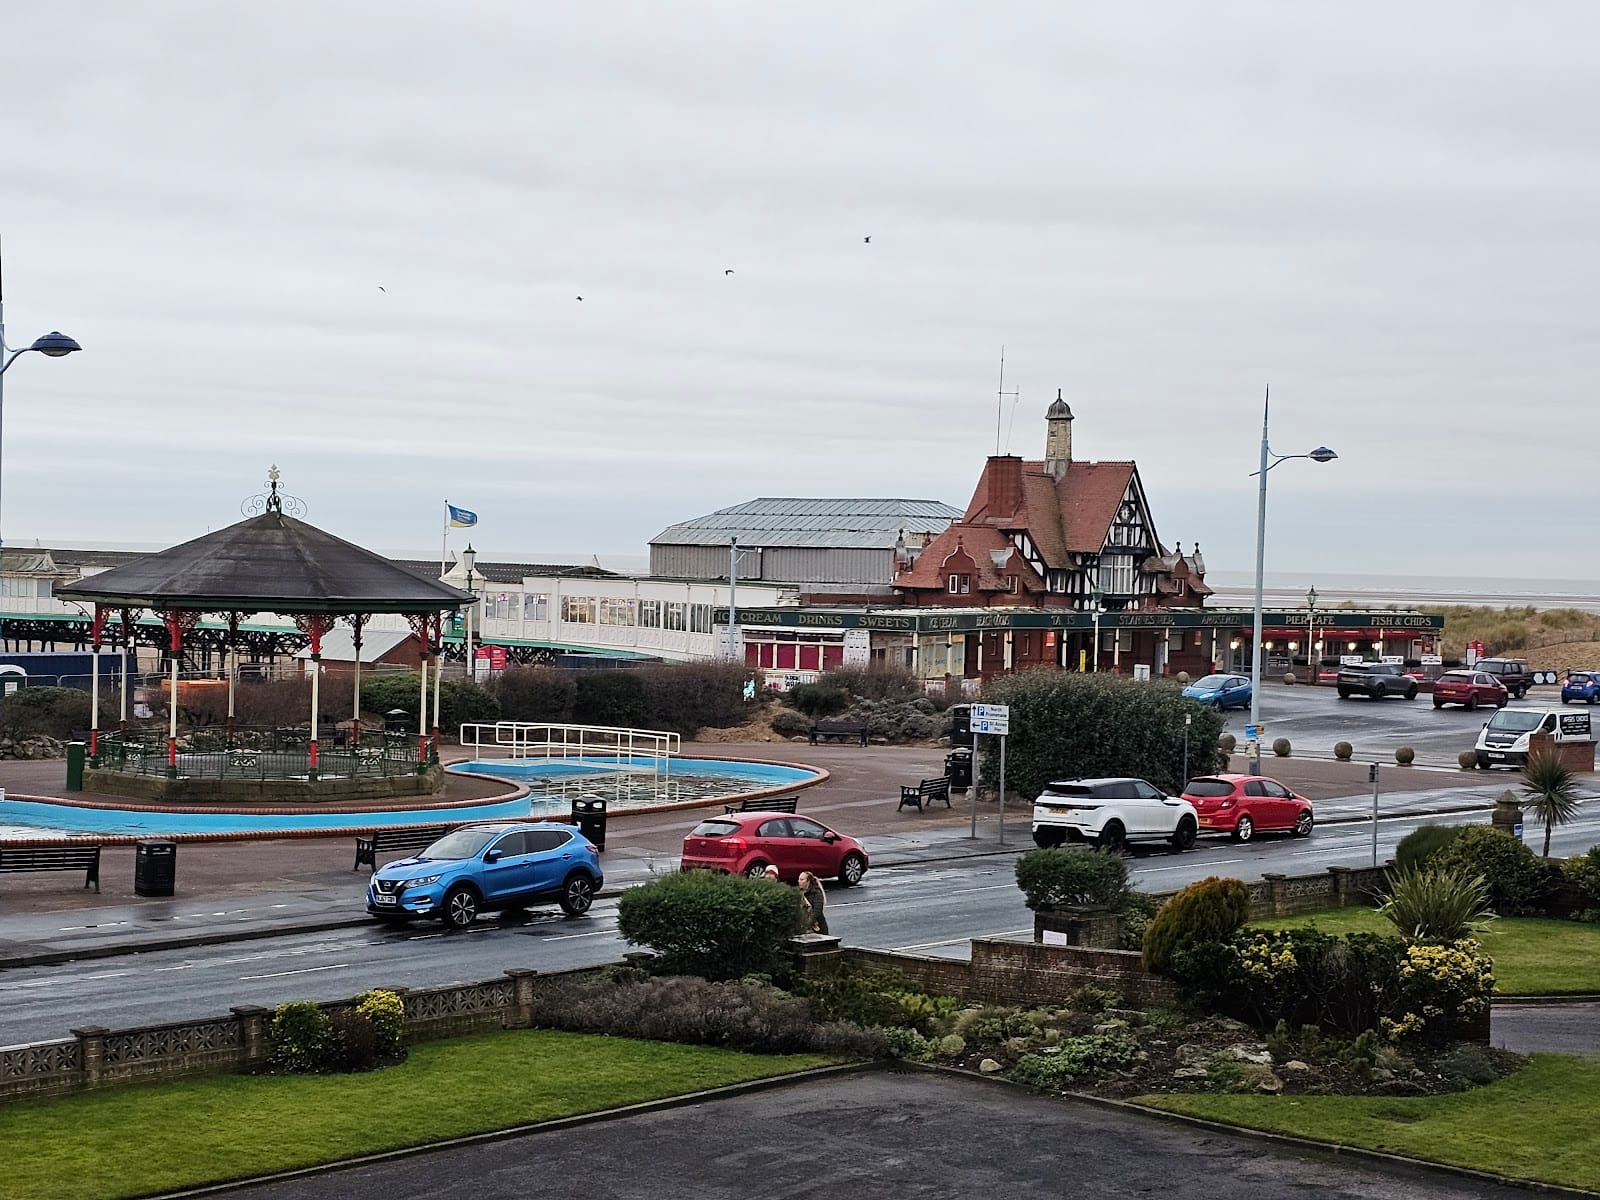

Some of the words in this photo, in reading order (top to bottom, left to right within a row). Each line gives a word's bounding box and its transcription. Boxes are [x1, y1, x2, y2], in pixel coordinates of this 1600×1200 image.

[718, 612, 737, 622] IC
[741, 612, 782, 623] CREAM
[799, 614, 843, 626] DRINKS
[858, 616, 910, 628] SWEETS
[1285, 616, 1307, 624] PIER
[1311, 616, 1335, 625] CAFE
[1371, 616, 1394, 625] FISH
[1394, 617, 1402, 625] &
[1404, 616, 1432, 626] CHIPS
